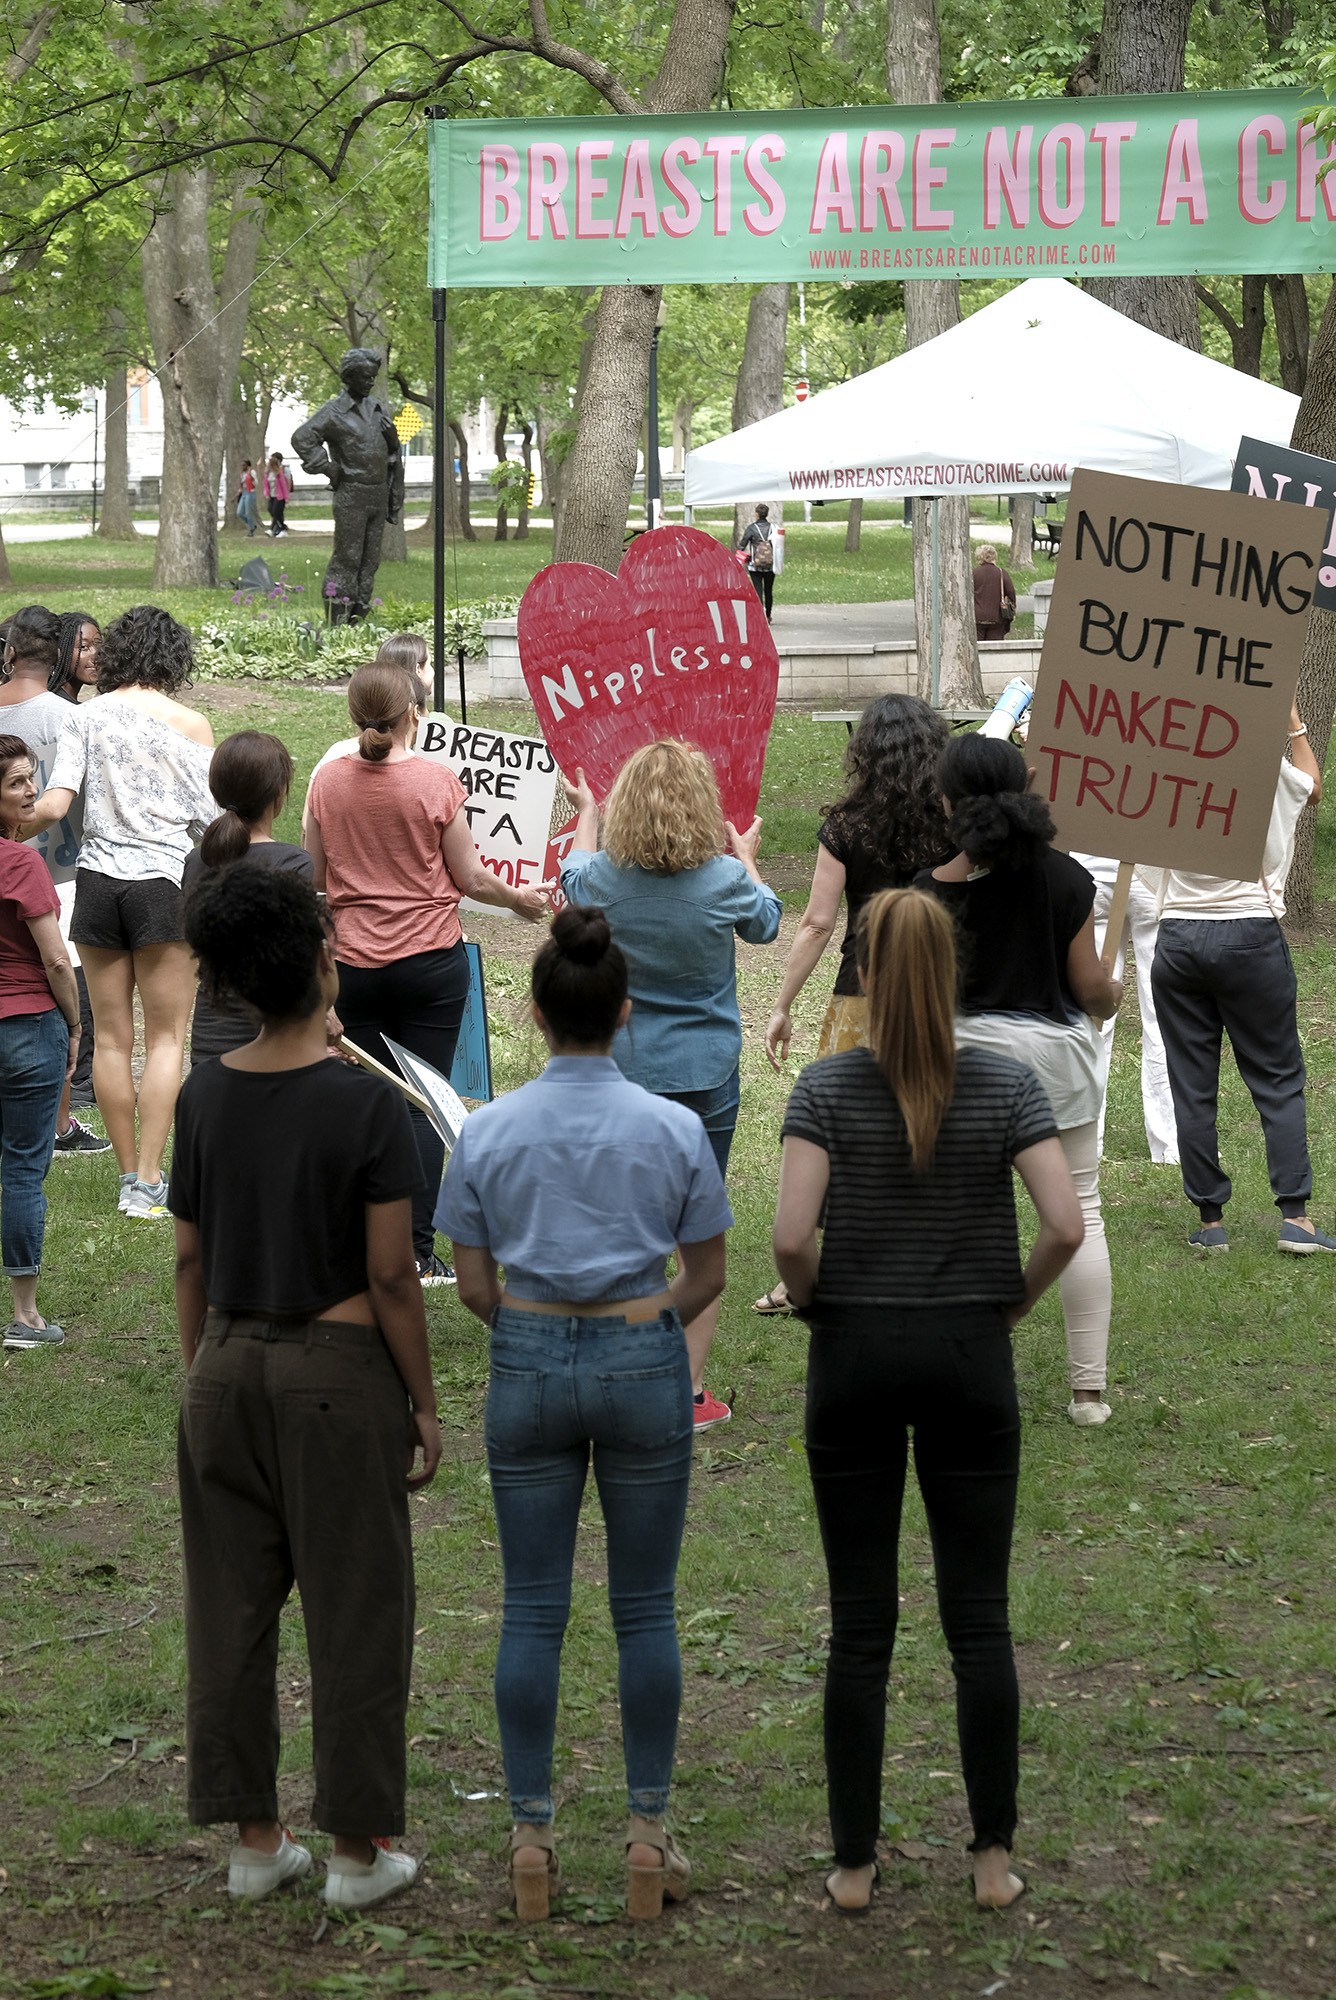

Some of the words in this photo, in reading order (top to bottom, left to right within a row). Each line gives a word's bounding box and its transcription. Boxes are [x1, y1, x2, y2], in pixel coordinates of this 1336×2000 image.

[480, 133, 787, 242] BREASTS
[808, 128, 957, 234] ARE
[983, 120, 1138, 230] NOT
[1156, 118, 1209, 226] A
[808, 243, 1117, 270] WWW.BREASTSARENOTACRIME.COM
[788, 462, 1069, 491] WWW.BREASTSARENOTACRIME.COM
[1074, 510, 1314, 615] NOTHING
[541, 599, 754, 723] Nipples!!
[1078, 598, 1185, 669] BUT
[1193, 626, 1274, 689] THE
[421, 722, 556, 774] BREASTS
[1053, 678, 1240, 760] NAKED
[458, 766, 521, 801] ARE
[1039, 745, 1239, 836] TRUTH
